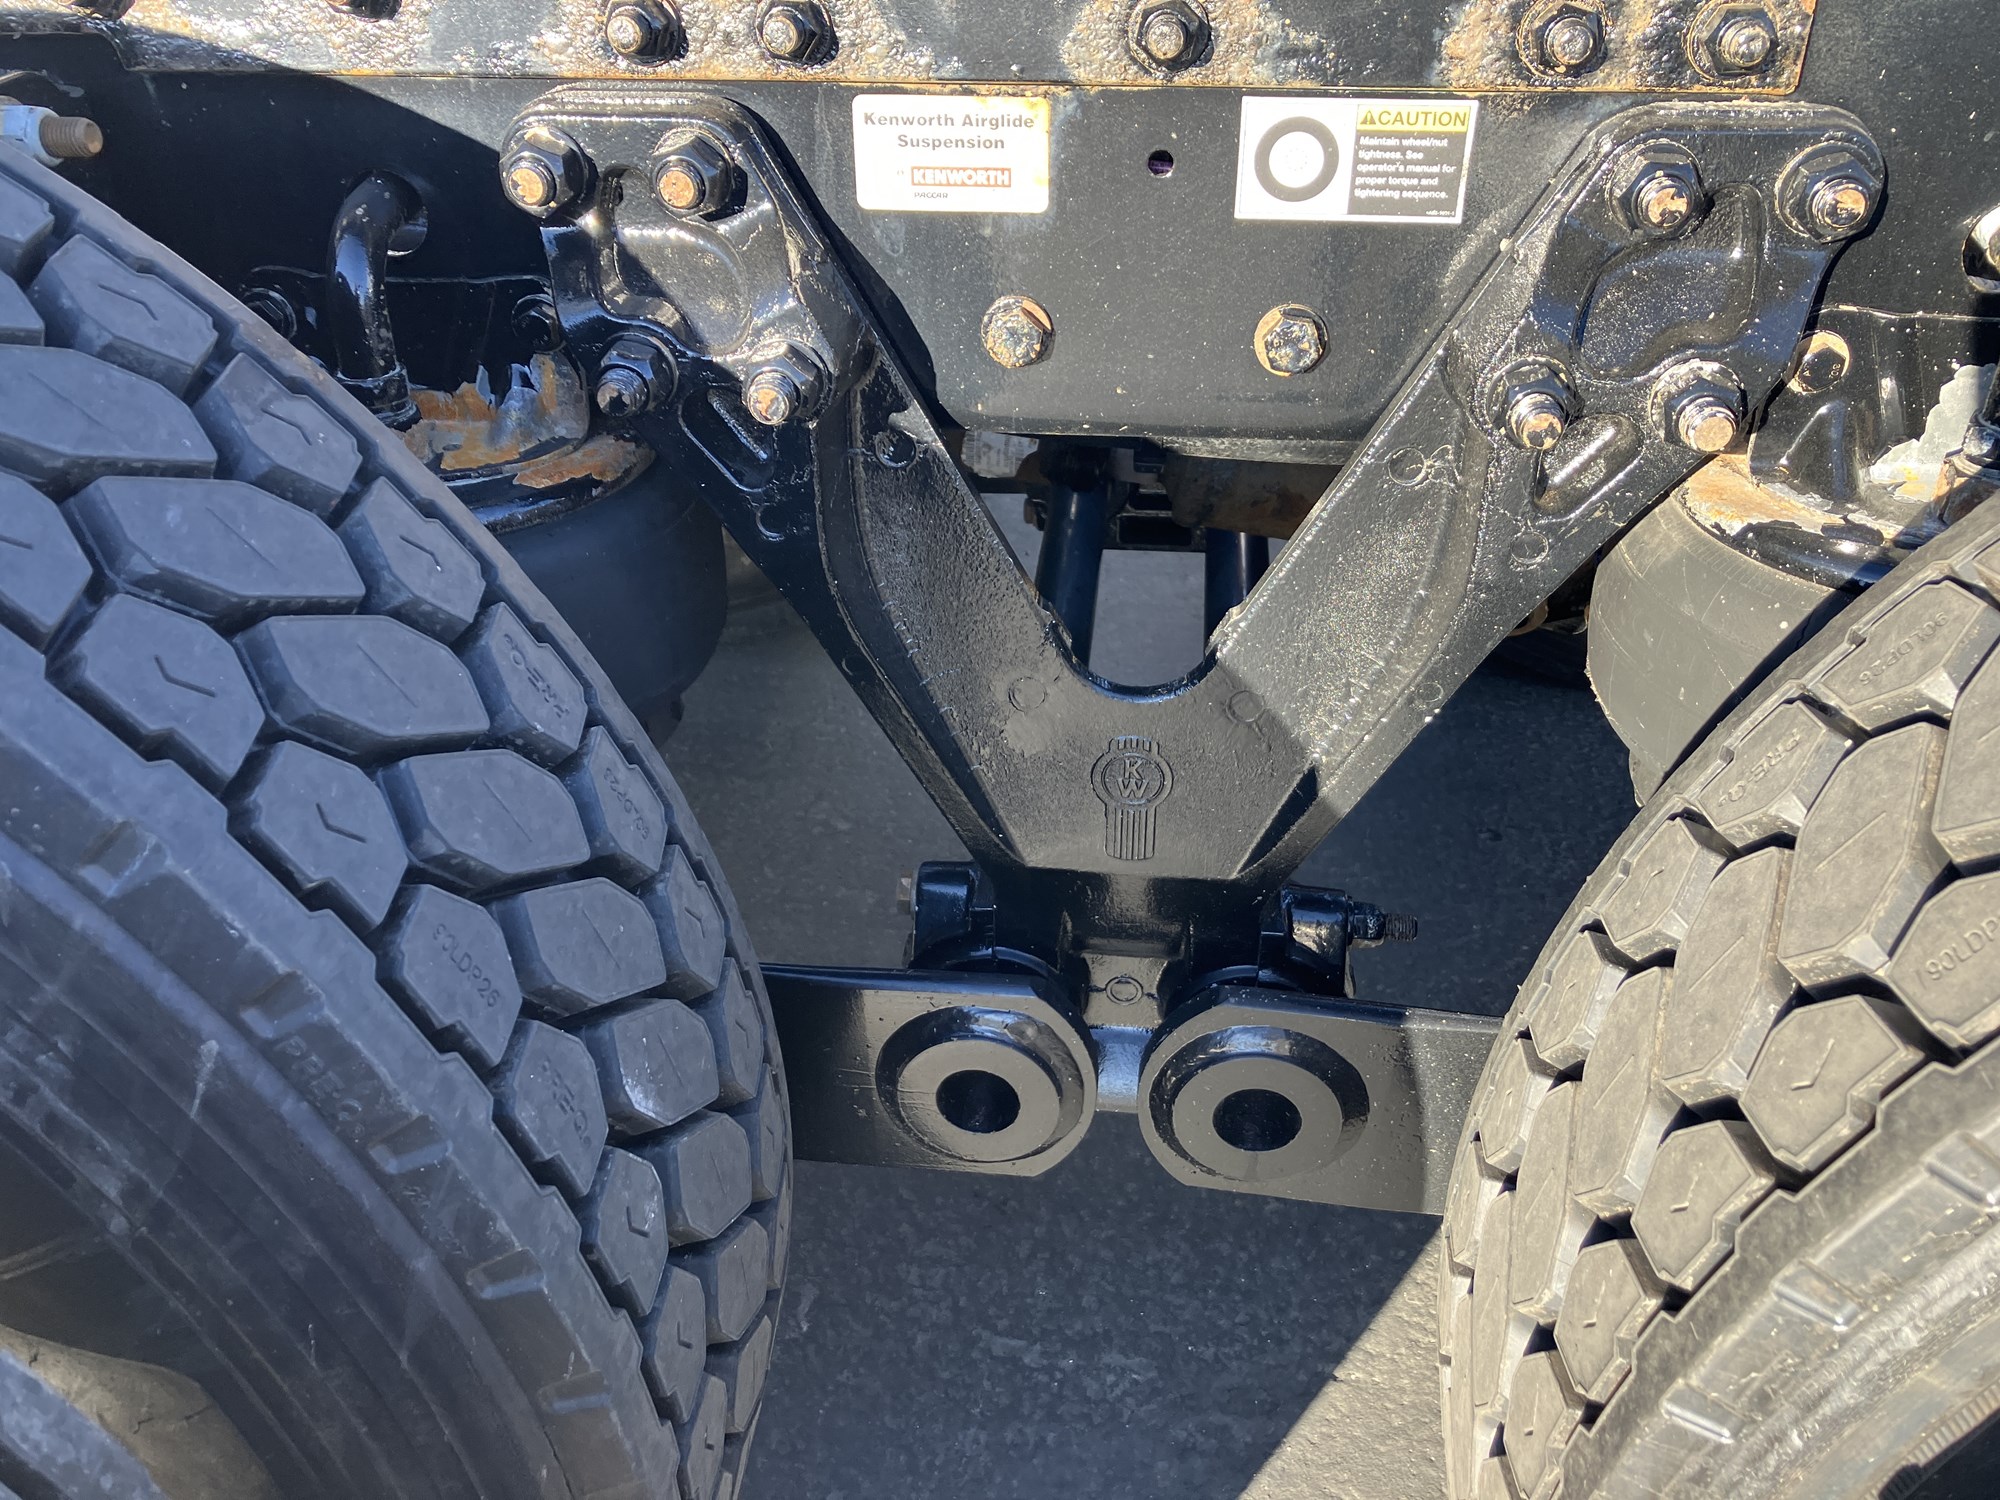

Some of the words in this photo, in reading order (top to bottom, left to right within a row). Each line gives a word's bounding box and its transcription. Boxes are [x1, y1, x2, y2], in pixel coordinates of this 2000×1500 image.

[863, 112, 955, 127] Kenworth
[961, 113, 1035, 130] Airglide
[1377, 110, 1467, 126] CAUTION
[897, 134, 1005, 150] Suspension
[1359, 136, 1399, 146] Maintain
[1405, 150, 1424, 160] See
[1406, 164, 1440, 172] manual
[1442, 164, 1457, 173] for
[913, 167, 1010, 187] KENWORTH
[1355, 176, 1387, 186] proper
[1388, 176, 1419, 187] torque
[1420, 177, 1439, 185] and
[913, 191, 949, 199] PACCAR
[1354, 188, 1401, 200] tightening
